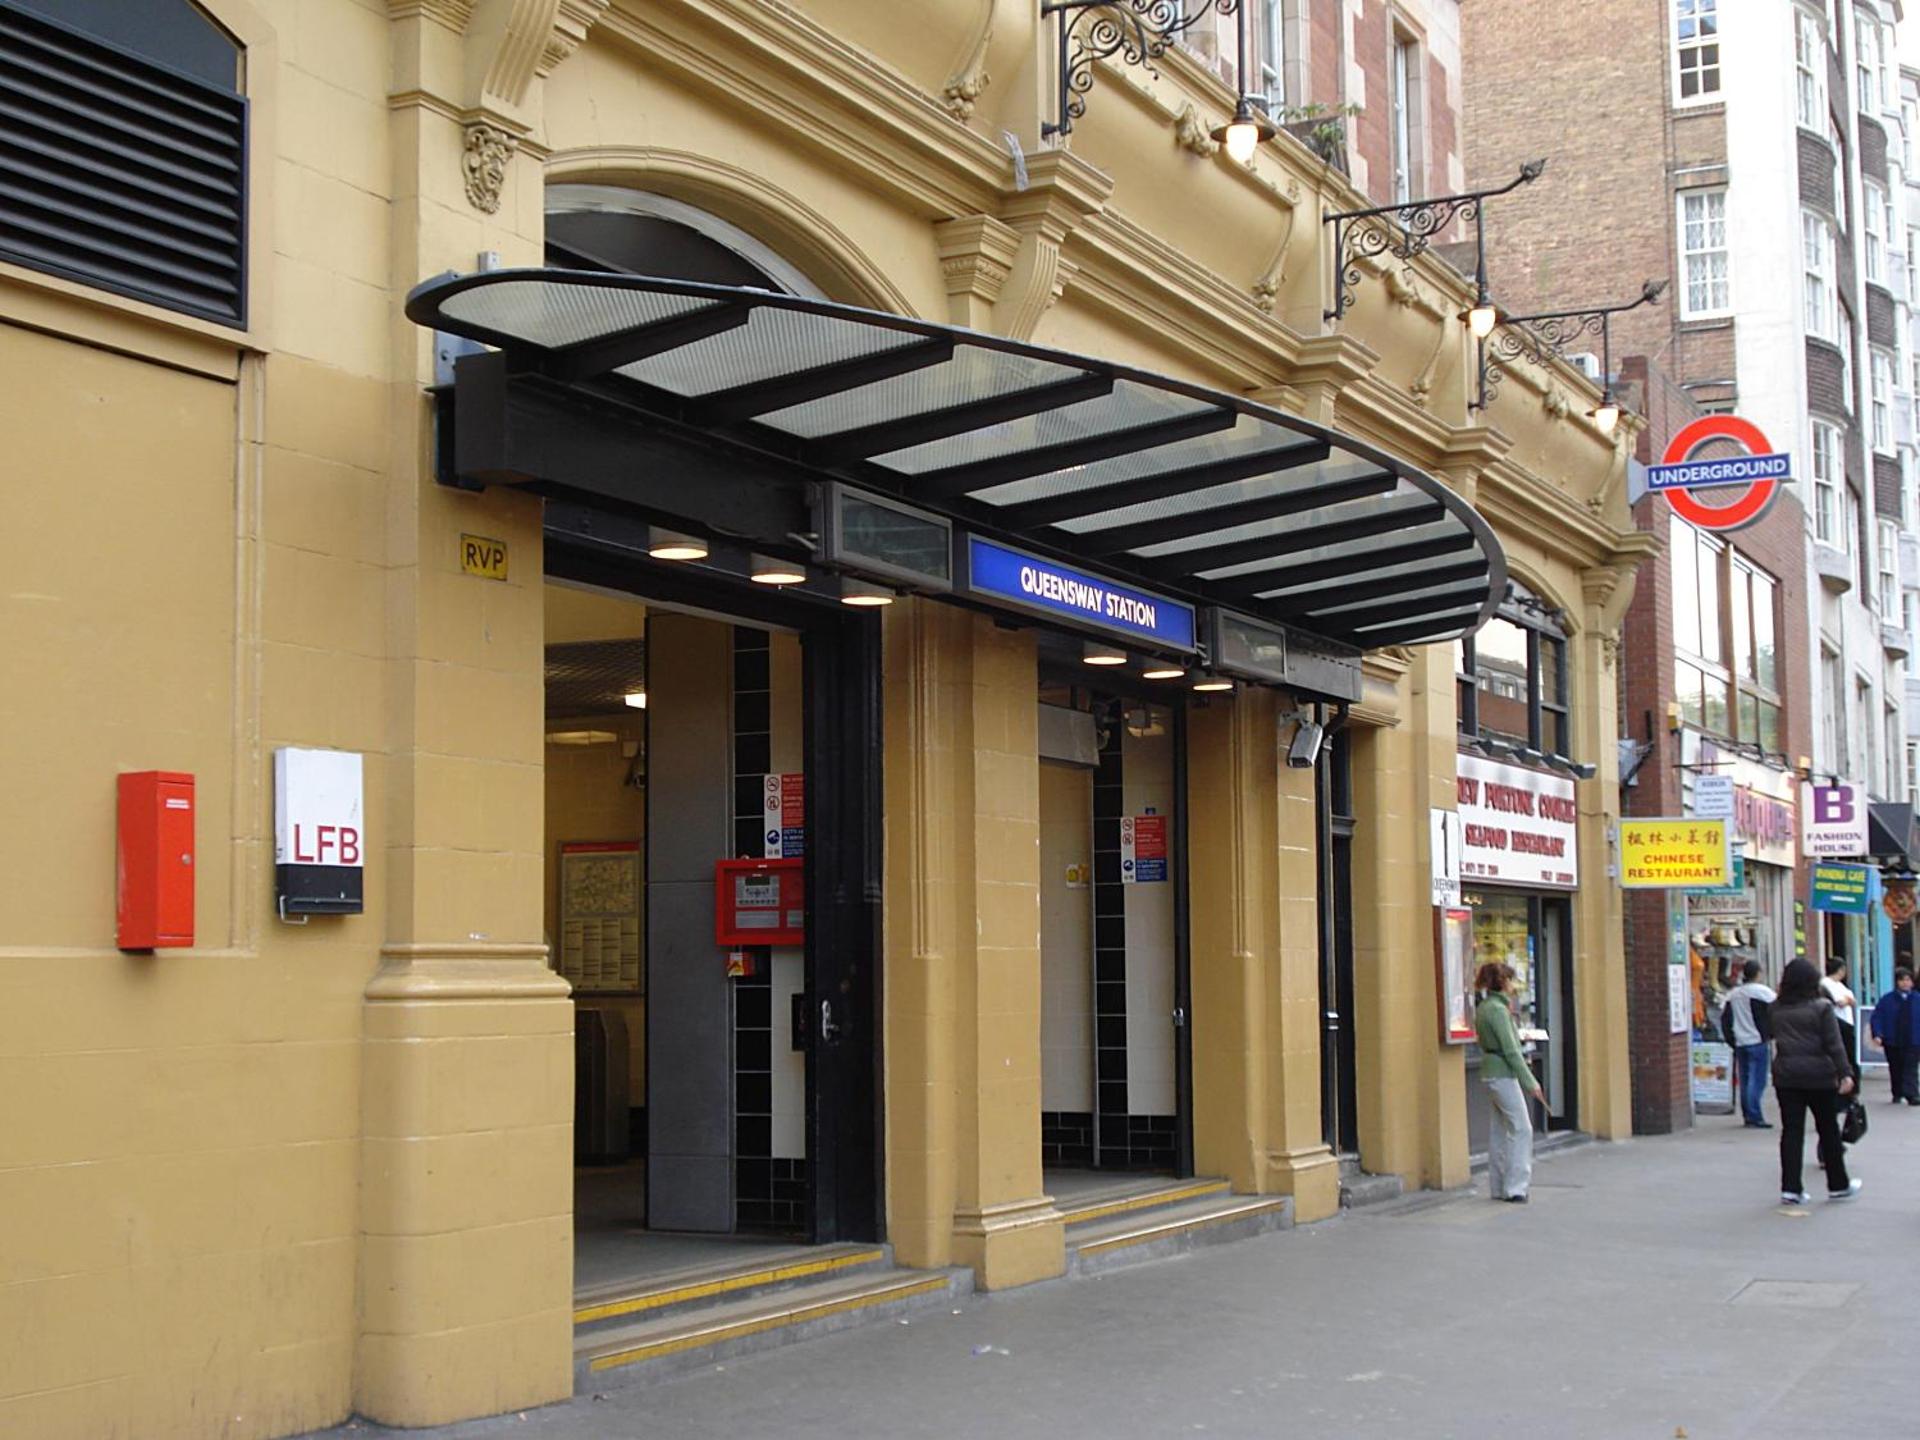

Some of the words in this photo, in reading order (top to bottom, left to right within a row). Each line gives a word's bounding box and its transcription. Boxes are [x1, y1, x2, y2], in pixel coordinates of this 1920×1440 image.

[1652, 459, 1786, 485] UNDERGROUND
[466, 543, 504, 571] RVP
[1020, 566, 1103, 613] QUEENSWAY
[1106, 592, 1156, 629] STATION
[1484, 782, 1535, 817] FORTUNE
[1814, 786, 1854, 824] B
[294, 824, 359, 864] LFB
[1465, 823, 1508, 850] SEAFOOD
[1511, 830, 1565, 858] RESTAURANT
[1807, 832, 1863, 841] FASHION
[1813, 844, 1856, 852] HOUSE
[1628, 867, 1721, 878] RESTAURANT
[1644, 854, 1705, 864] CHINESE
